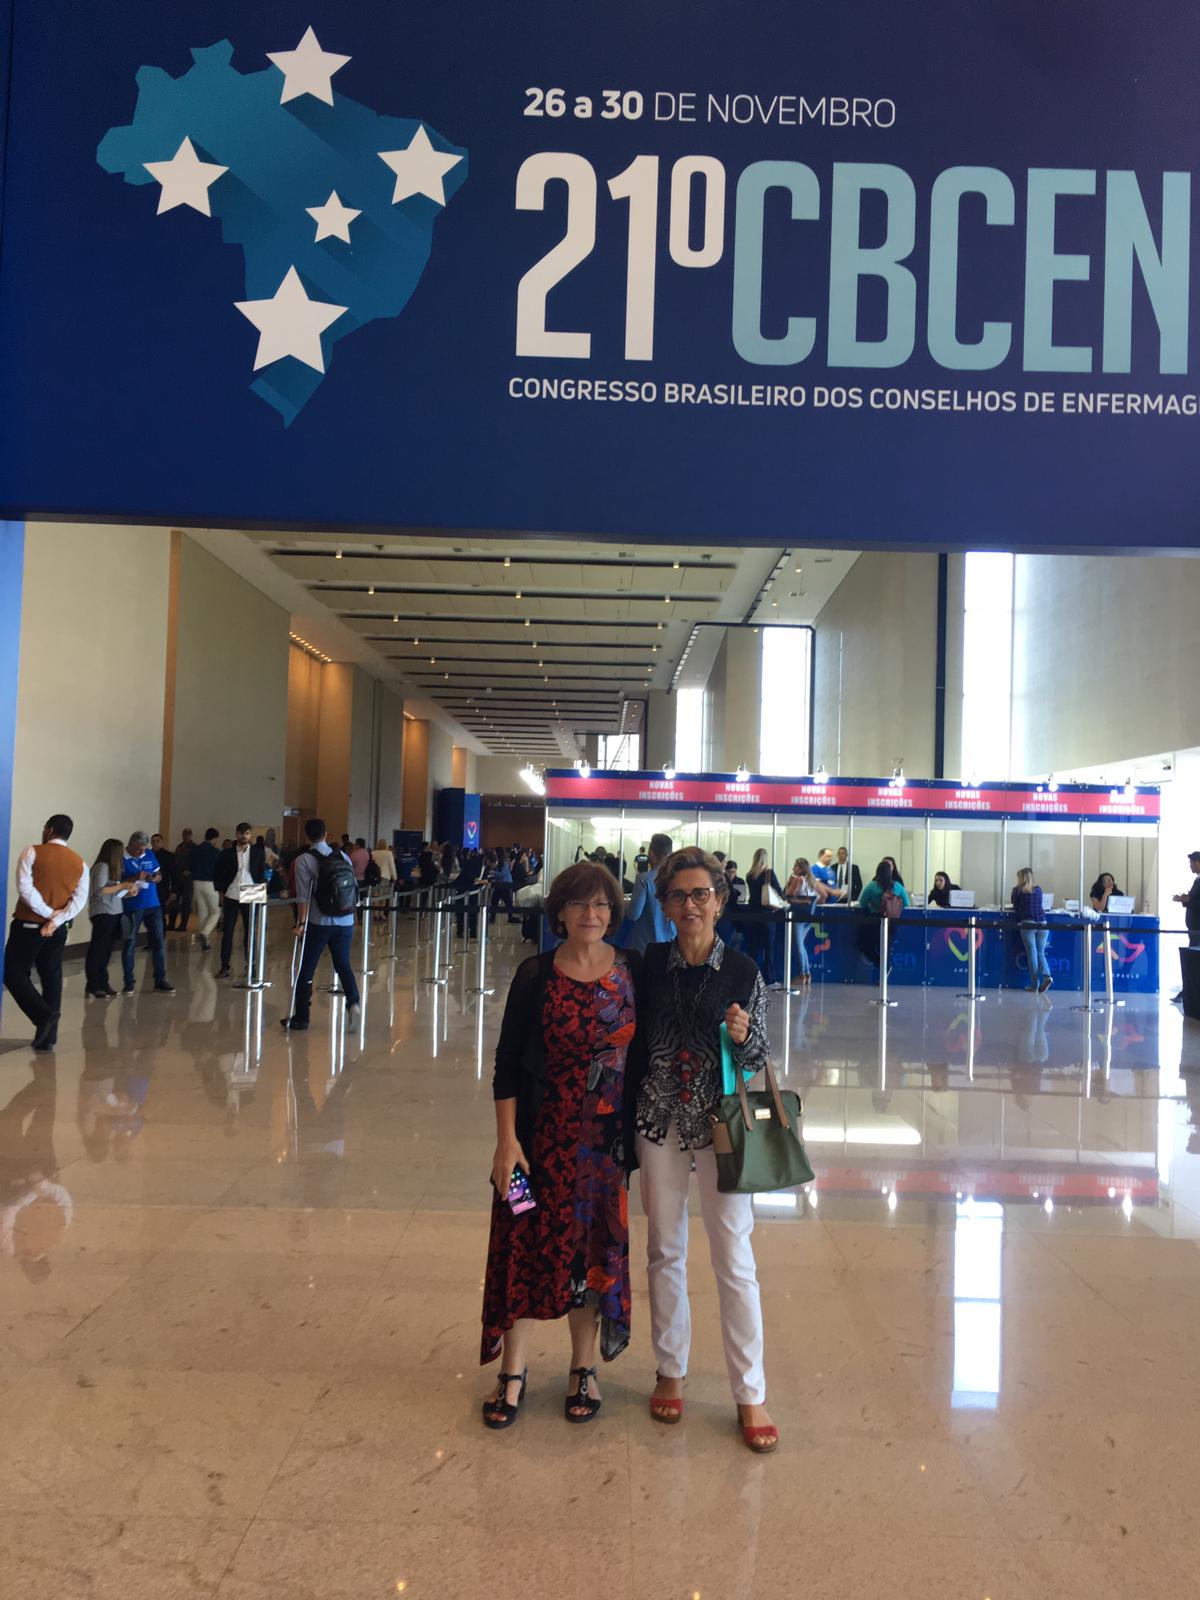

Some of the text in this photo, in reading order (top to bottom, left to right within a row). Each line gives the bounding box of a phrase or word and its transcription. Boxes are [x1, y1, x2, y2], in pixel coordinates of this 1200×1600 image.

[523, 88, 896, 128] 26 a 30 DE NOVEMBRO
[731, 160, 1192, 375] CBCEN
[508, 378, 1200, 416] CONGRESSO BRASILEIRO DOS CONSELHOS DE ENFERMAG
[648, 780, 675, 789] NOVAS
[725, 783, 750, 792] NOVAS
[801, 785, 826, 794] NOVAS
[639, 790, 684, 801] INSCRIÇÕES
[877, 787, 903, 796] NOVAS
[955, 789, 980, 799] NOVAS
[1032, 792, 1057, 802] NOVAS
[714, 793, 760, 803] INSCRIÇÕES
[791, 795, 836, 806] INSCRIÇÕES
[867, 797, 913, 808] INSCRIÇÕES
[944, 800, 990, 811] INSCRIÇÕES
[1022, 802, 1068, 813] INSCRIÇÕES
